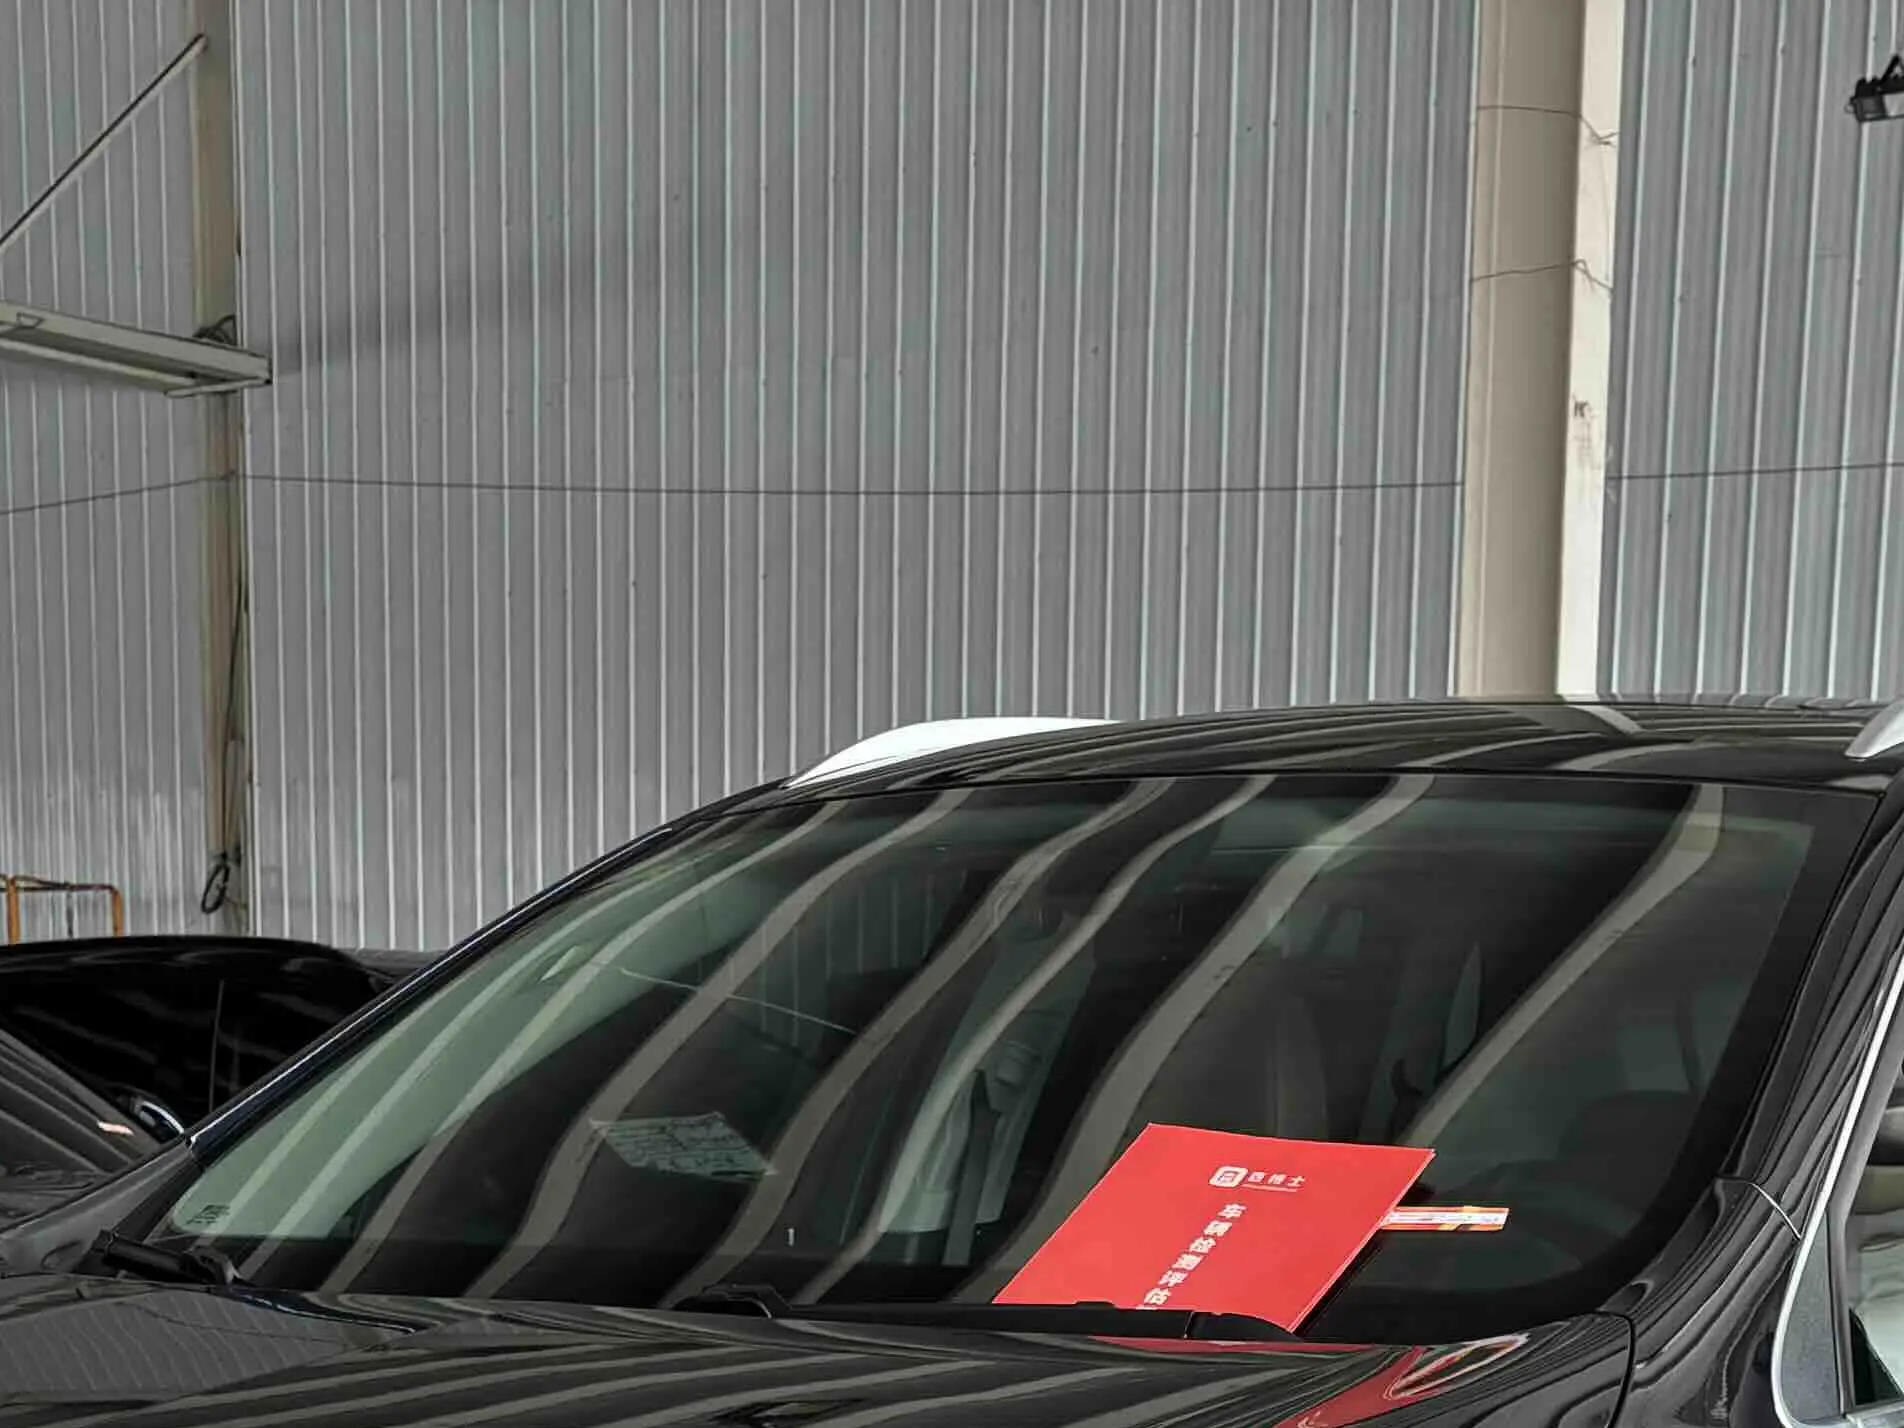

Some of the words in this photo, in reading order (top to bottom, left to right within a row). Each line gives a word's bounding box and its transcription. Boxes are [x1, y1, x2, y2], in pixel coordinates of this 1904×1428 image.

[1136, 1203, 1247, 1310] 车辆检测评估
